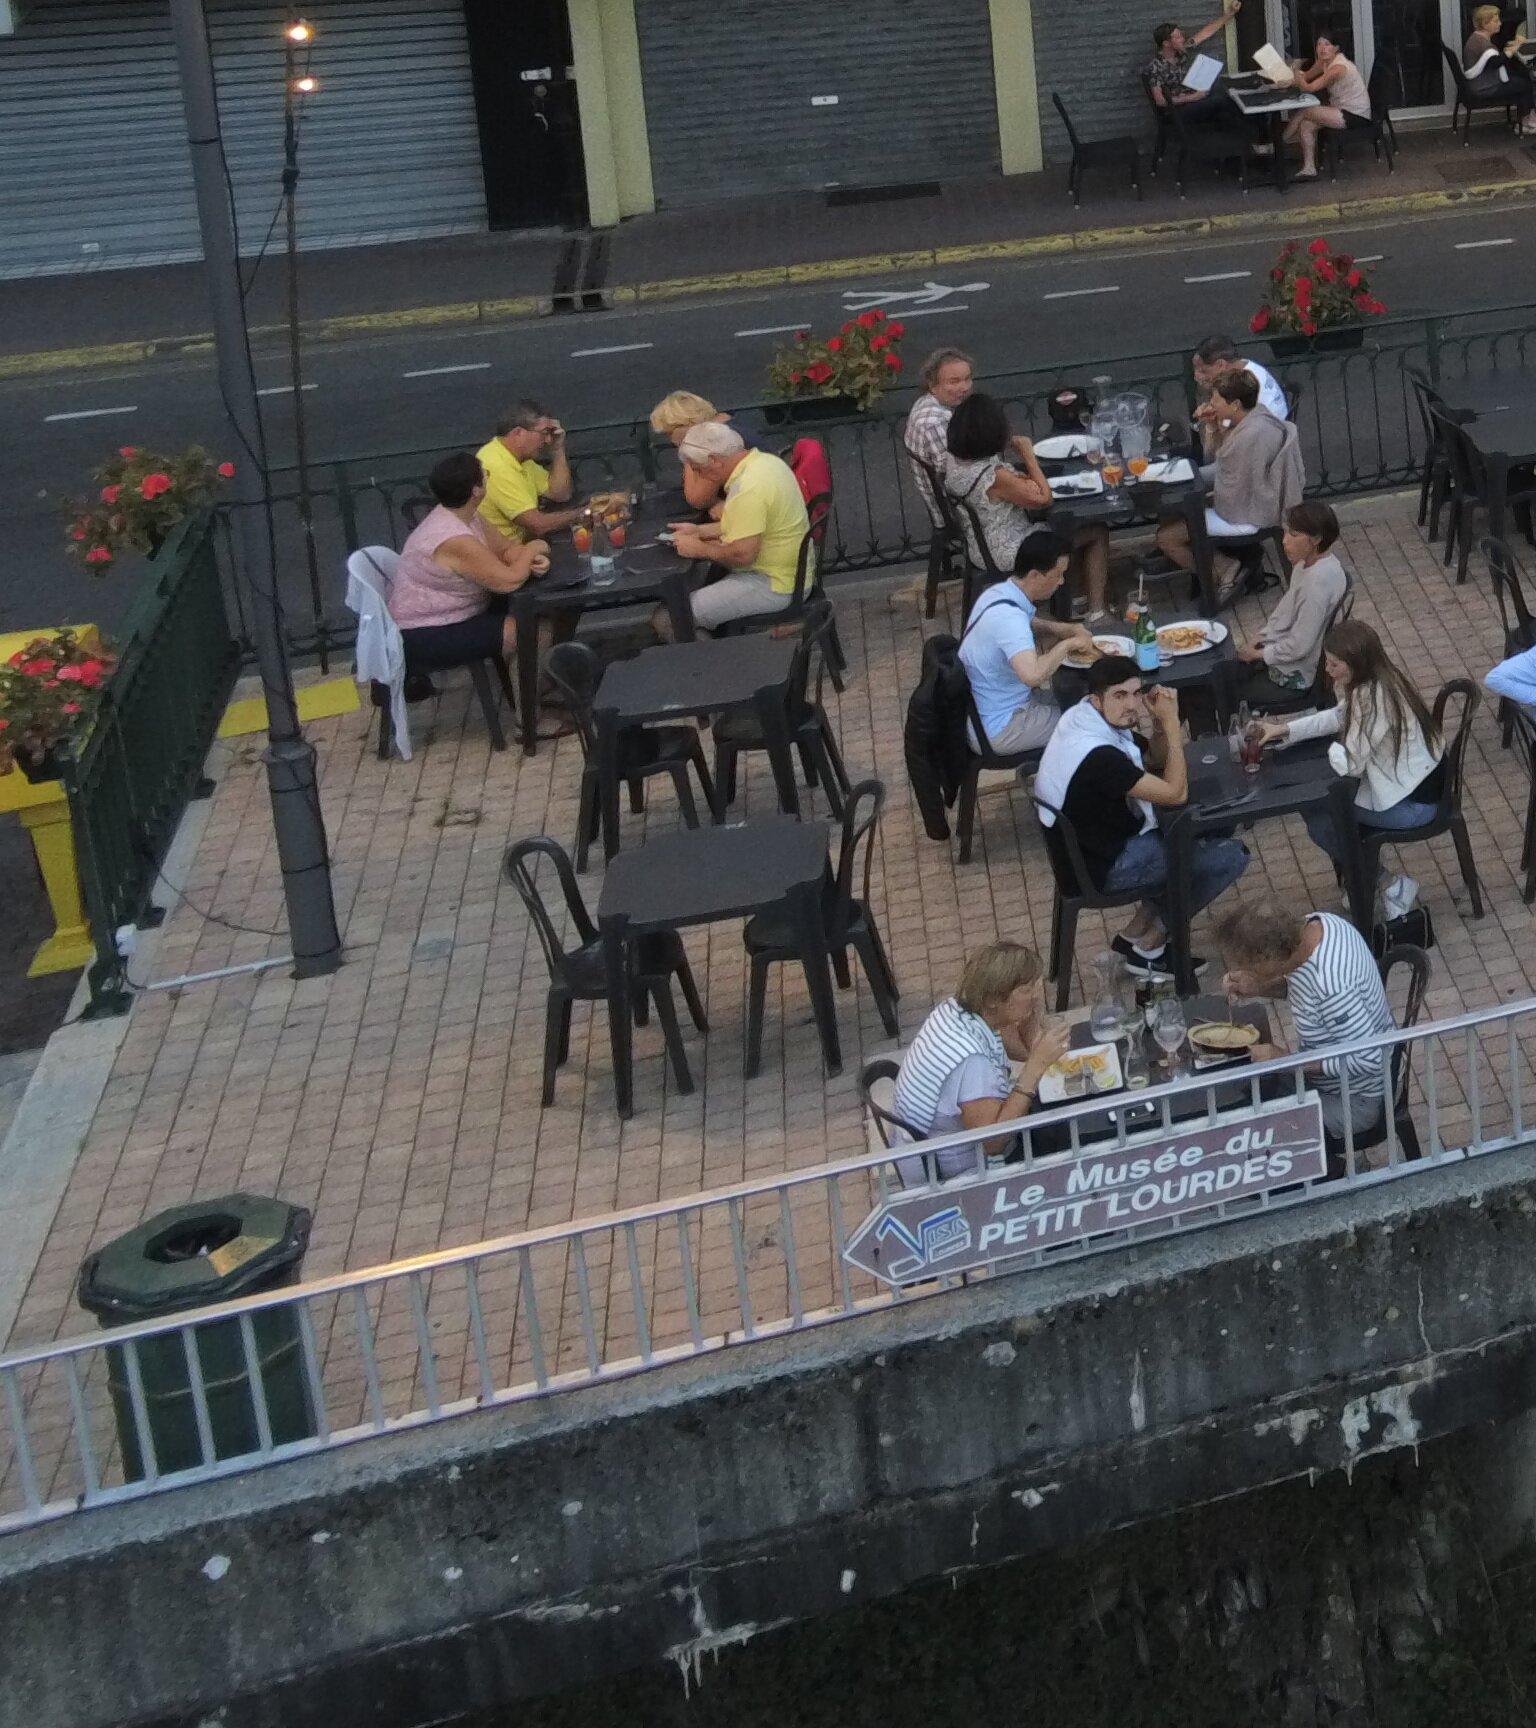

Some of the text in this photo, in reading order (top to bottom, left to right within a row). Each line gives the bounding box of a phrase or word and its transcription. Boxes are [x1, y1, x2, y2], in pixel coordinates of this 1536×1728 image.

[978, 1149, 1294, 1252] PETIT LOURDES
[994, 1127, 1275, 1214] Le Musée du
